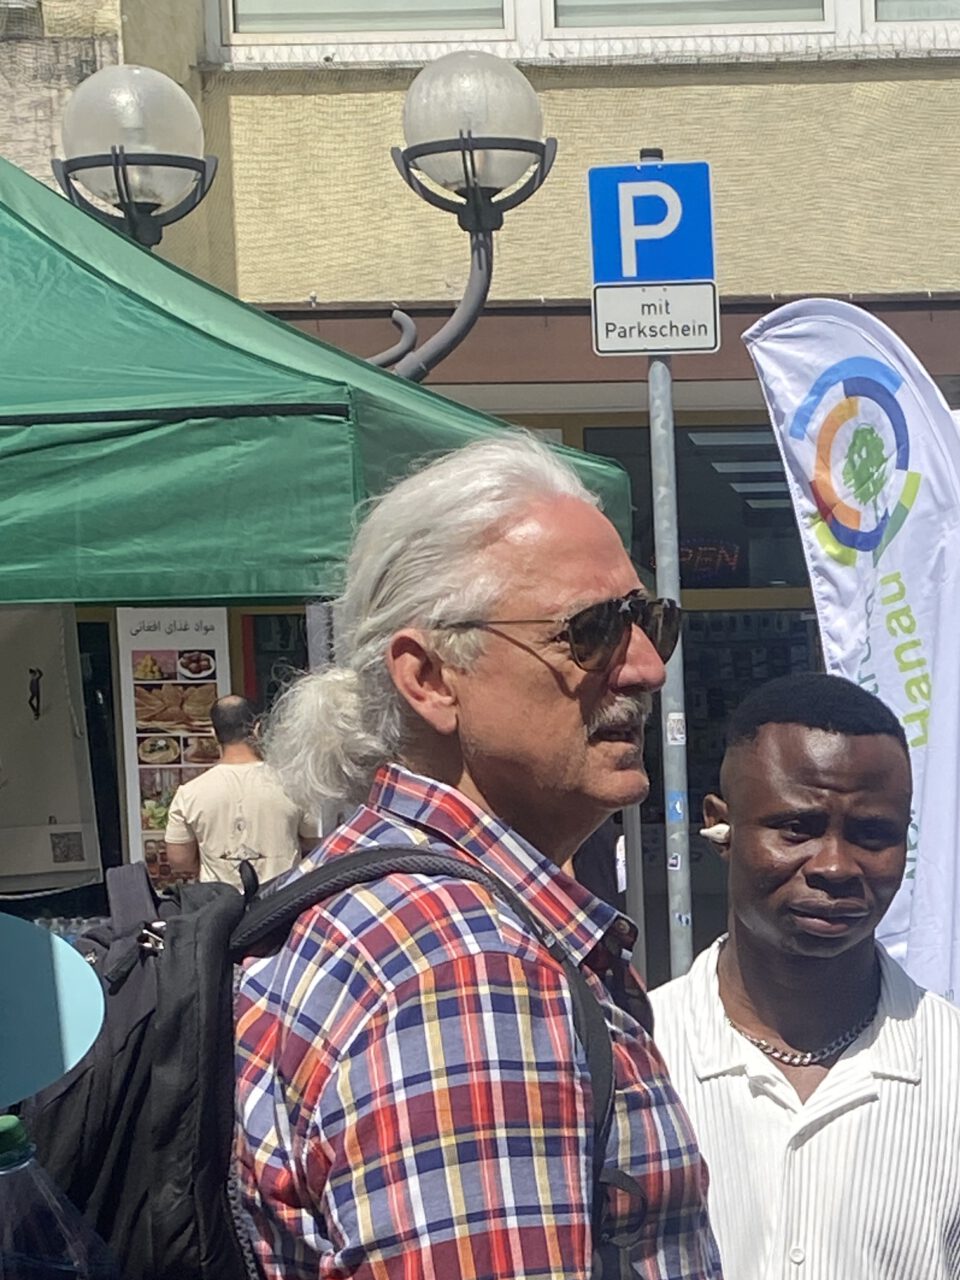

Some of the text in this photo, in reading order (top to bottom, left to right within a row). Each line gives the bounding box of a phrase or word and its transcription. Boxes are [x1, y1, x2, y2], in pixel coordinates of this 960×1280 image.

[617, 180, 683, 278] P
[640, 298, 671, 316] mit
[604, 320, 708, 339] Parkschein
